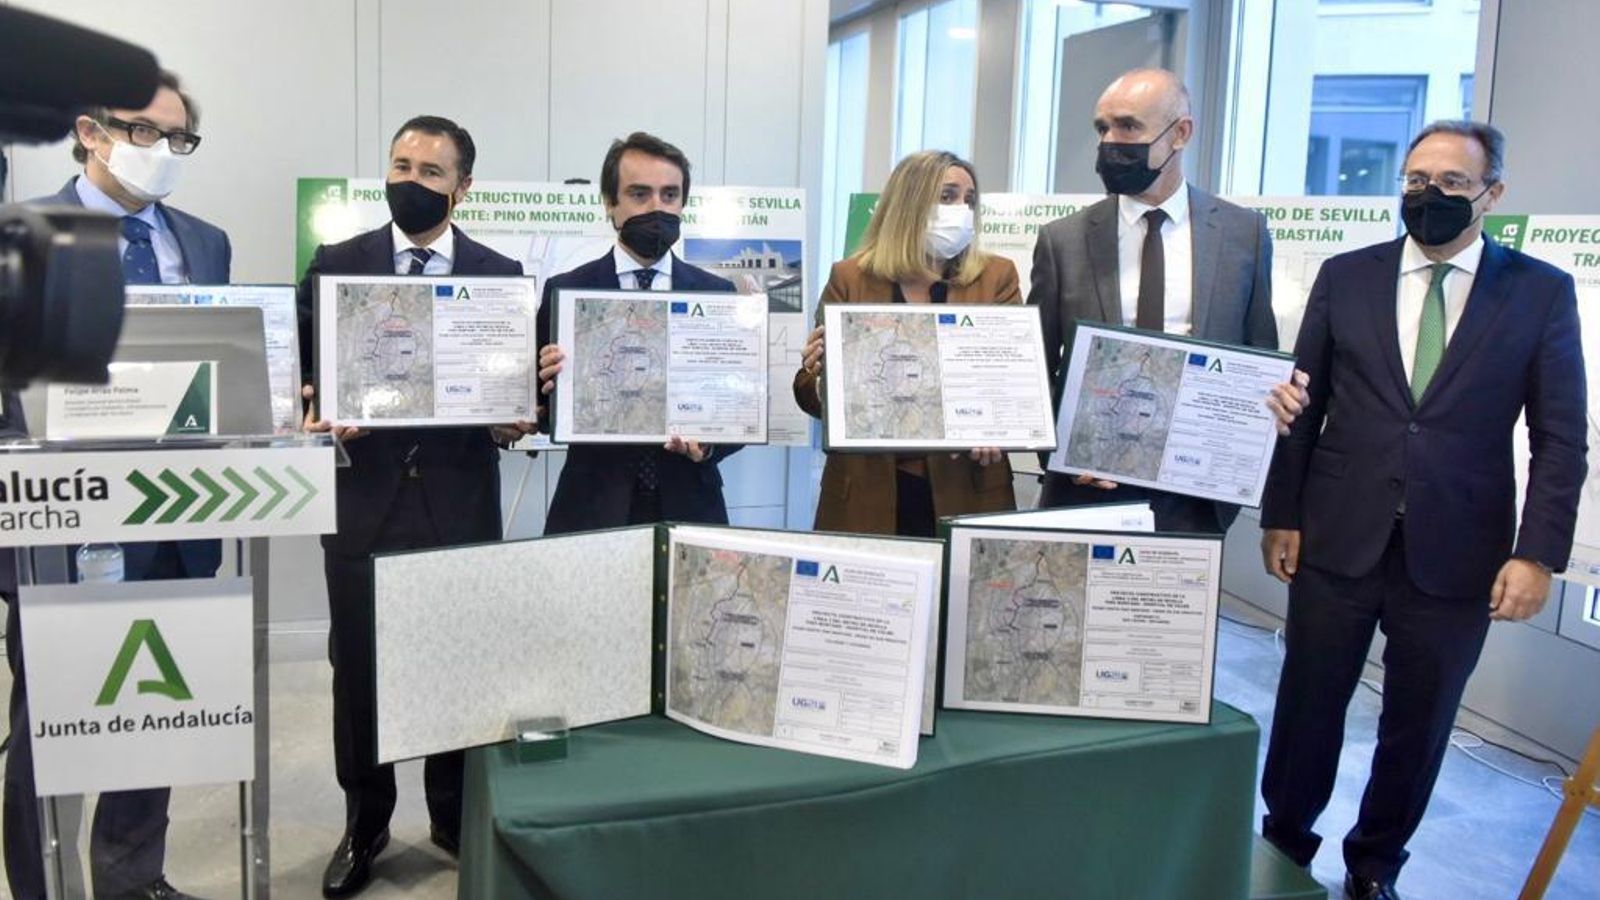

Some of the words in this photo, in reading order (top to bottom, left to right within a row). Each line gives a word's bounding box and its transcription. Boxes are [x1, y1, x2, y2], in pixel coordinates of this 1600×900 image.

[547, 193, 565, 205] DE
[569, 193, 586, 205] LA
[749, 197, 801, 210] SEVILLA
[494, 210, 526, 221] PINO
[530, 211, 595, 223] MONTANO
[1292, 207, 1314, 221] DE
[1320, 208, 1391, 223] SEVILLA
[35, 719, 101, 739] Junta
[107, 714, 136, 733] de
[141, 704, 253, 732] Andalucía
